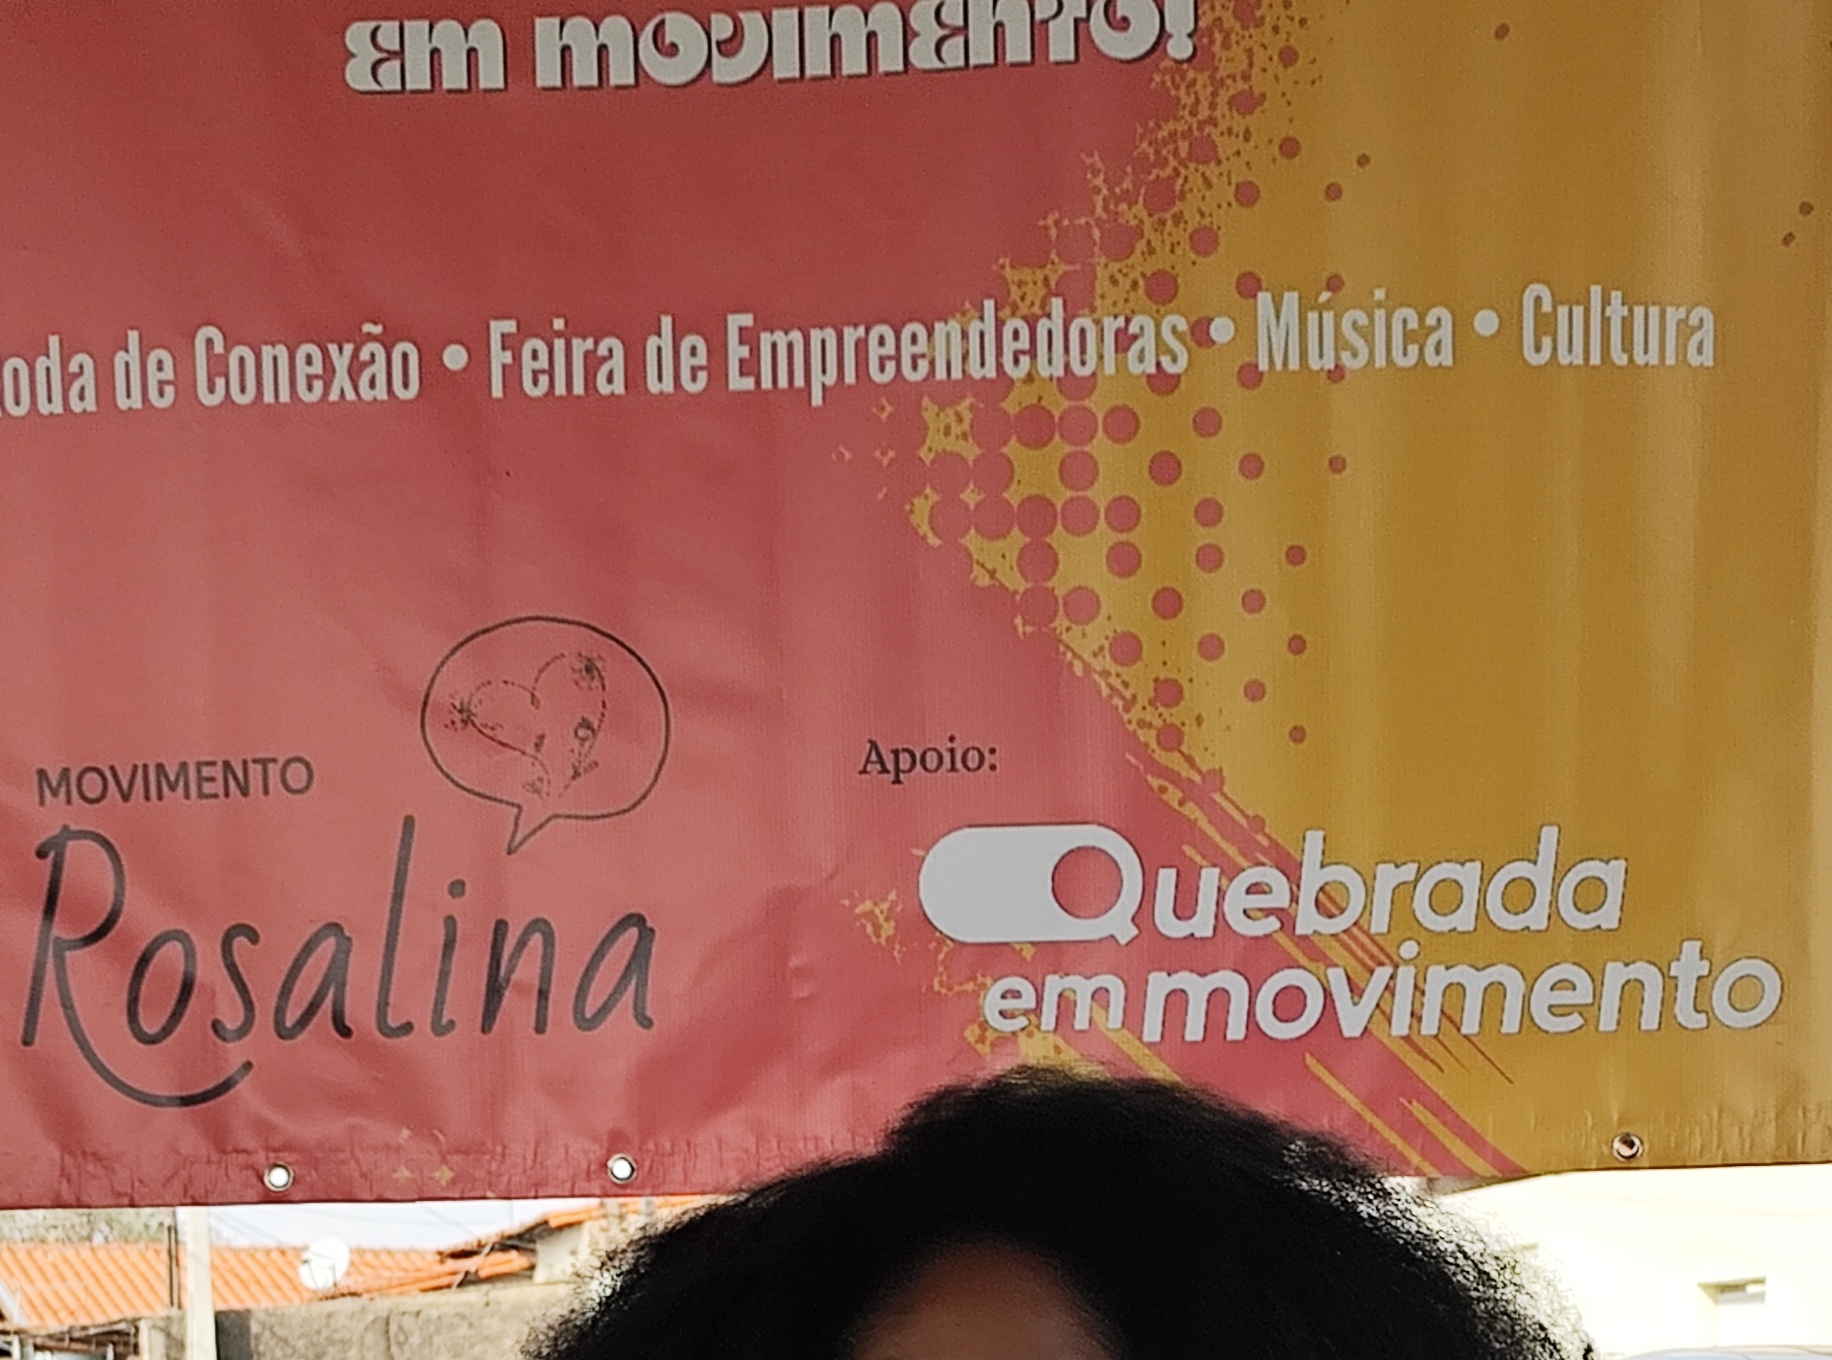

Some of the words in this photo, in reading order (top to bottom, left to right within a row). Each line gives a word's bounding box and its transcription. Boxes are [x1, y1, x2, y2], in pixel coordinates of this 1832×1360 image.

[0, 335, 96, 416] oda
[113, 329, 176, 411] de
[195, 322, 420, 406] Conexão
[489, 317, 626, 398] Feira
[646, 314, 708, 394] de
[726, 296, 1189, 407] Empreendedoras
[1256, 287, 1454, 371] Música
[1522, 283, 1715, 367] Cultura
[35, 755, 315, 807] MOVIMENTO
[858, 737, 999, 784] Apoio:
[918, 823, 1628, 946] Quebrada
[21, 815, 656, 1108] Rosalina
[981, 968, 1125, 1034] em
[1142, 939, 1784, 1044] movimento
